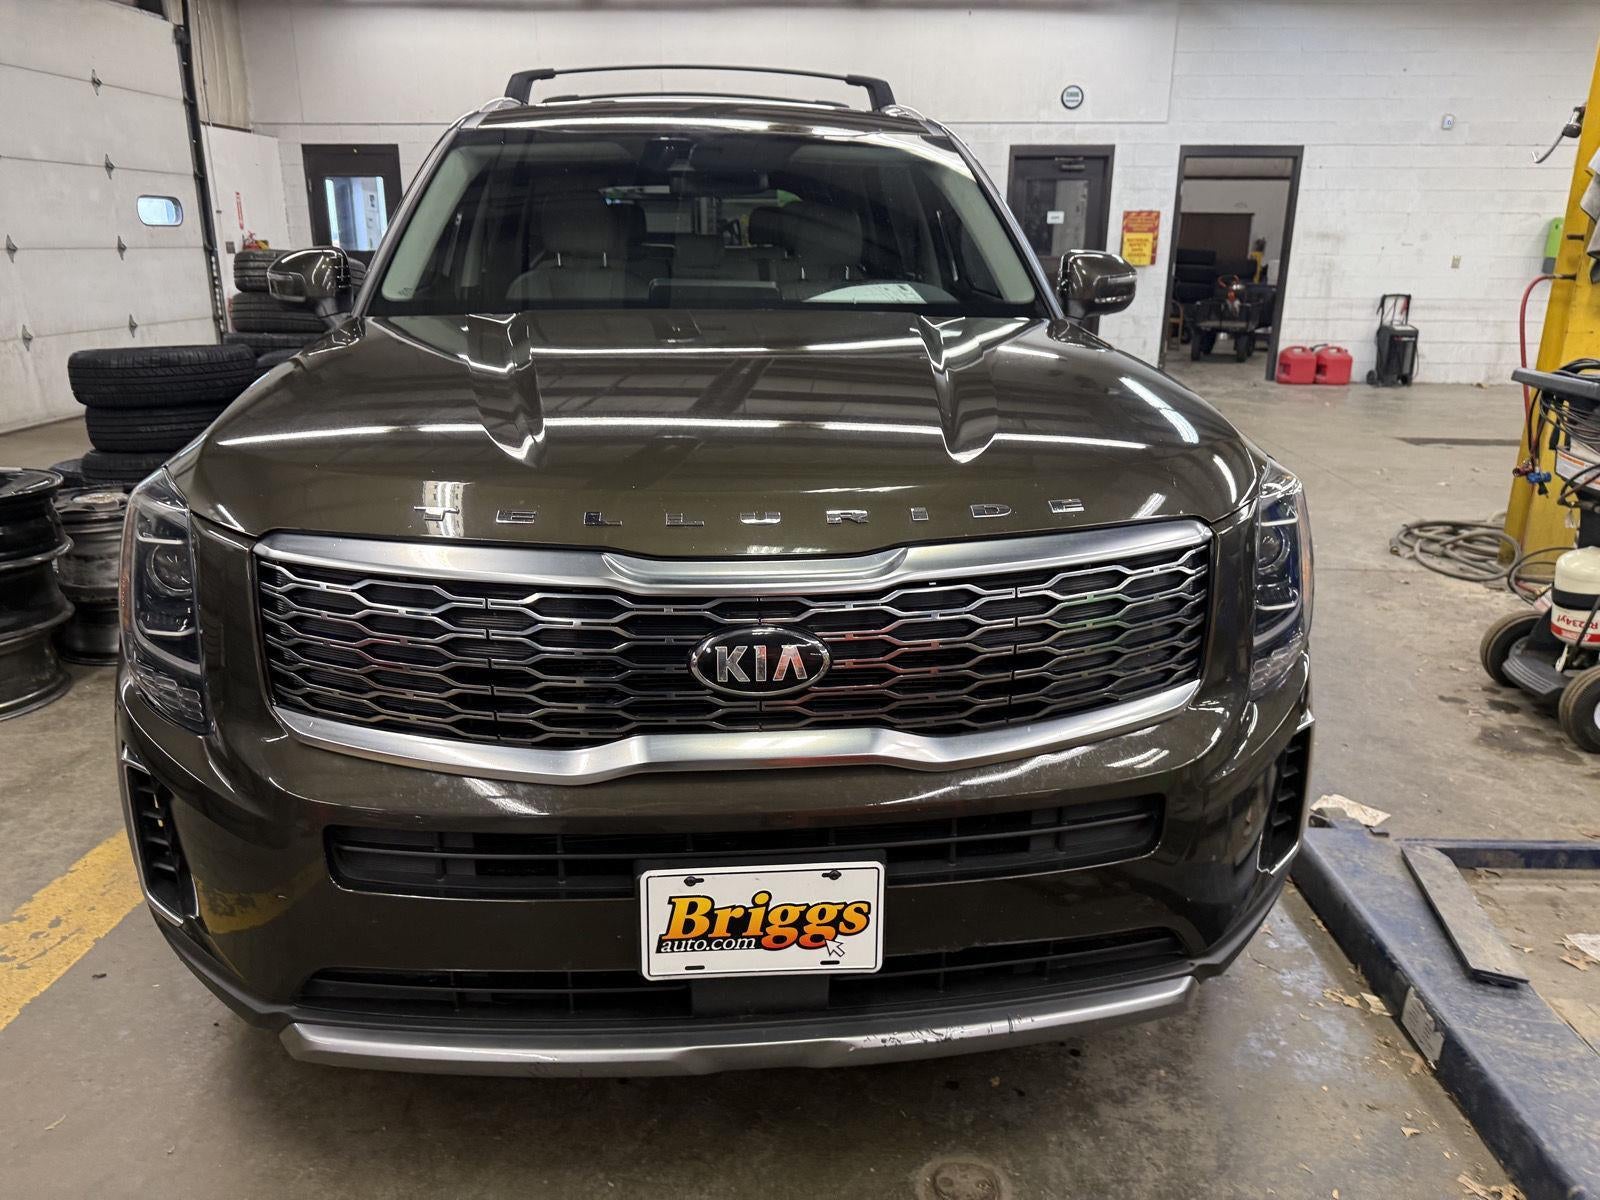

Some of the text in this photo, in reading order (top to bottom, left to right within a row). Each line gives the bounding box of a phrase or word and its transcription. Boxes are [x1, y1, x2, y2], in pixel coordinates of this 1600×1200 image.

[414, 498, 1085, 526] TELLURIDE
[715, 645, 808, 682] KIA
[660, 890, 872, 951] Briggs
[660, 937, 756, 953] auto.com
